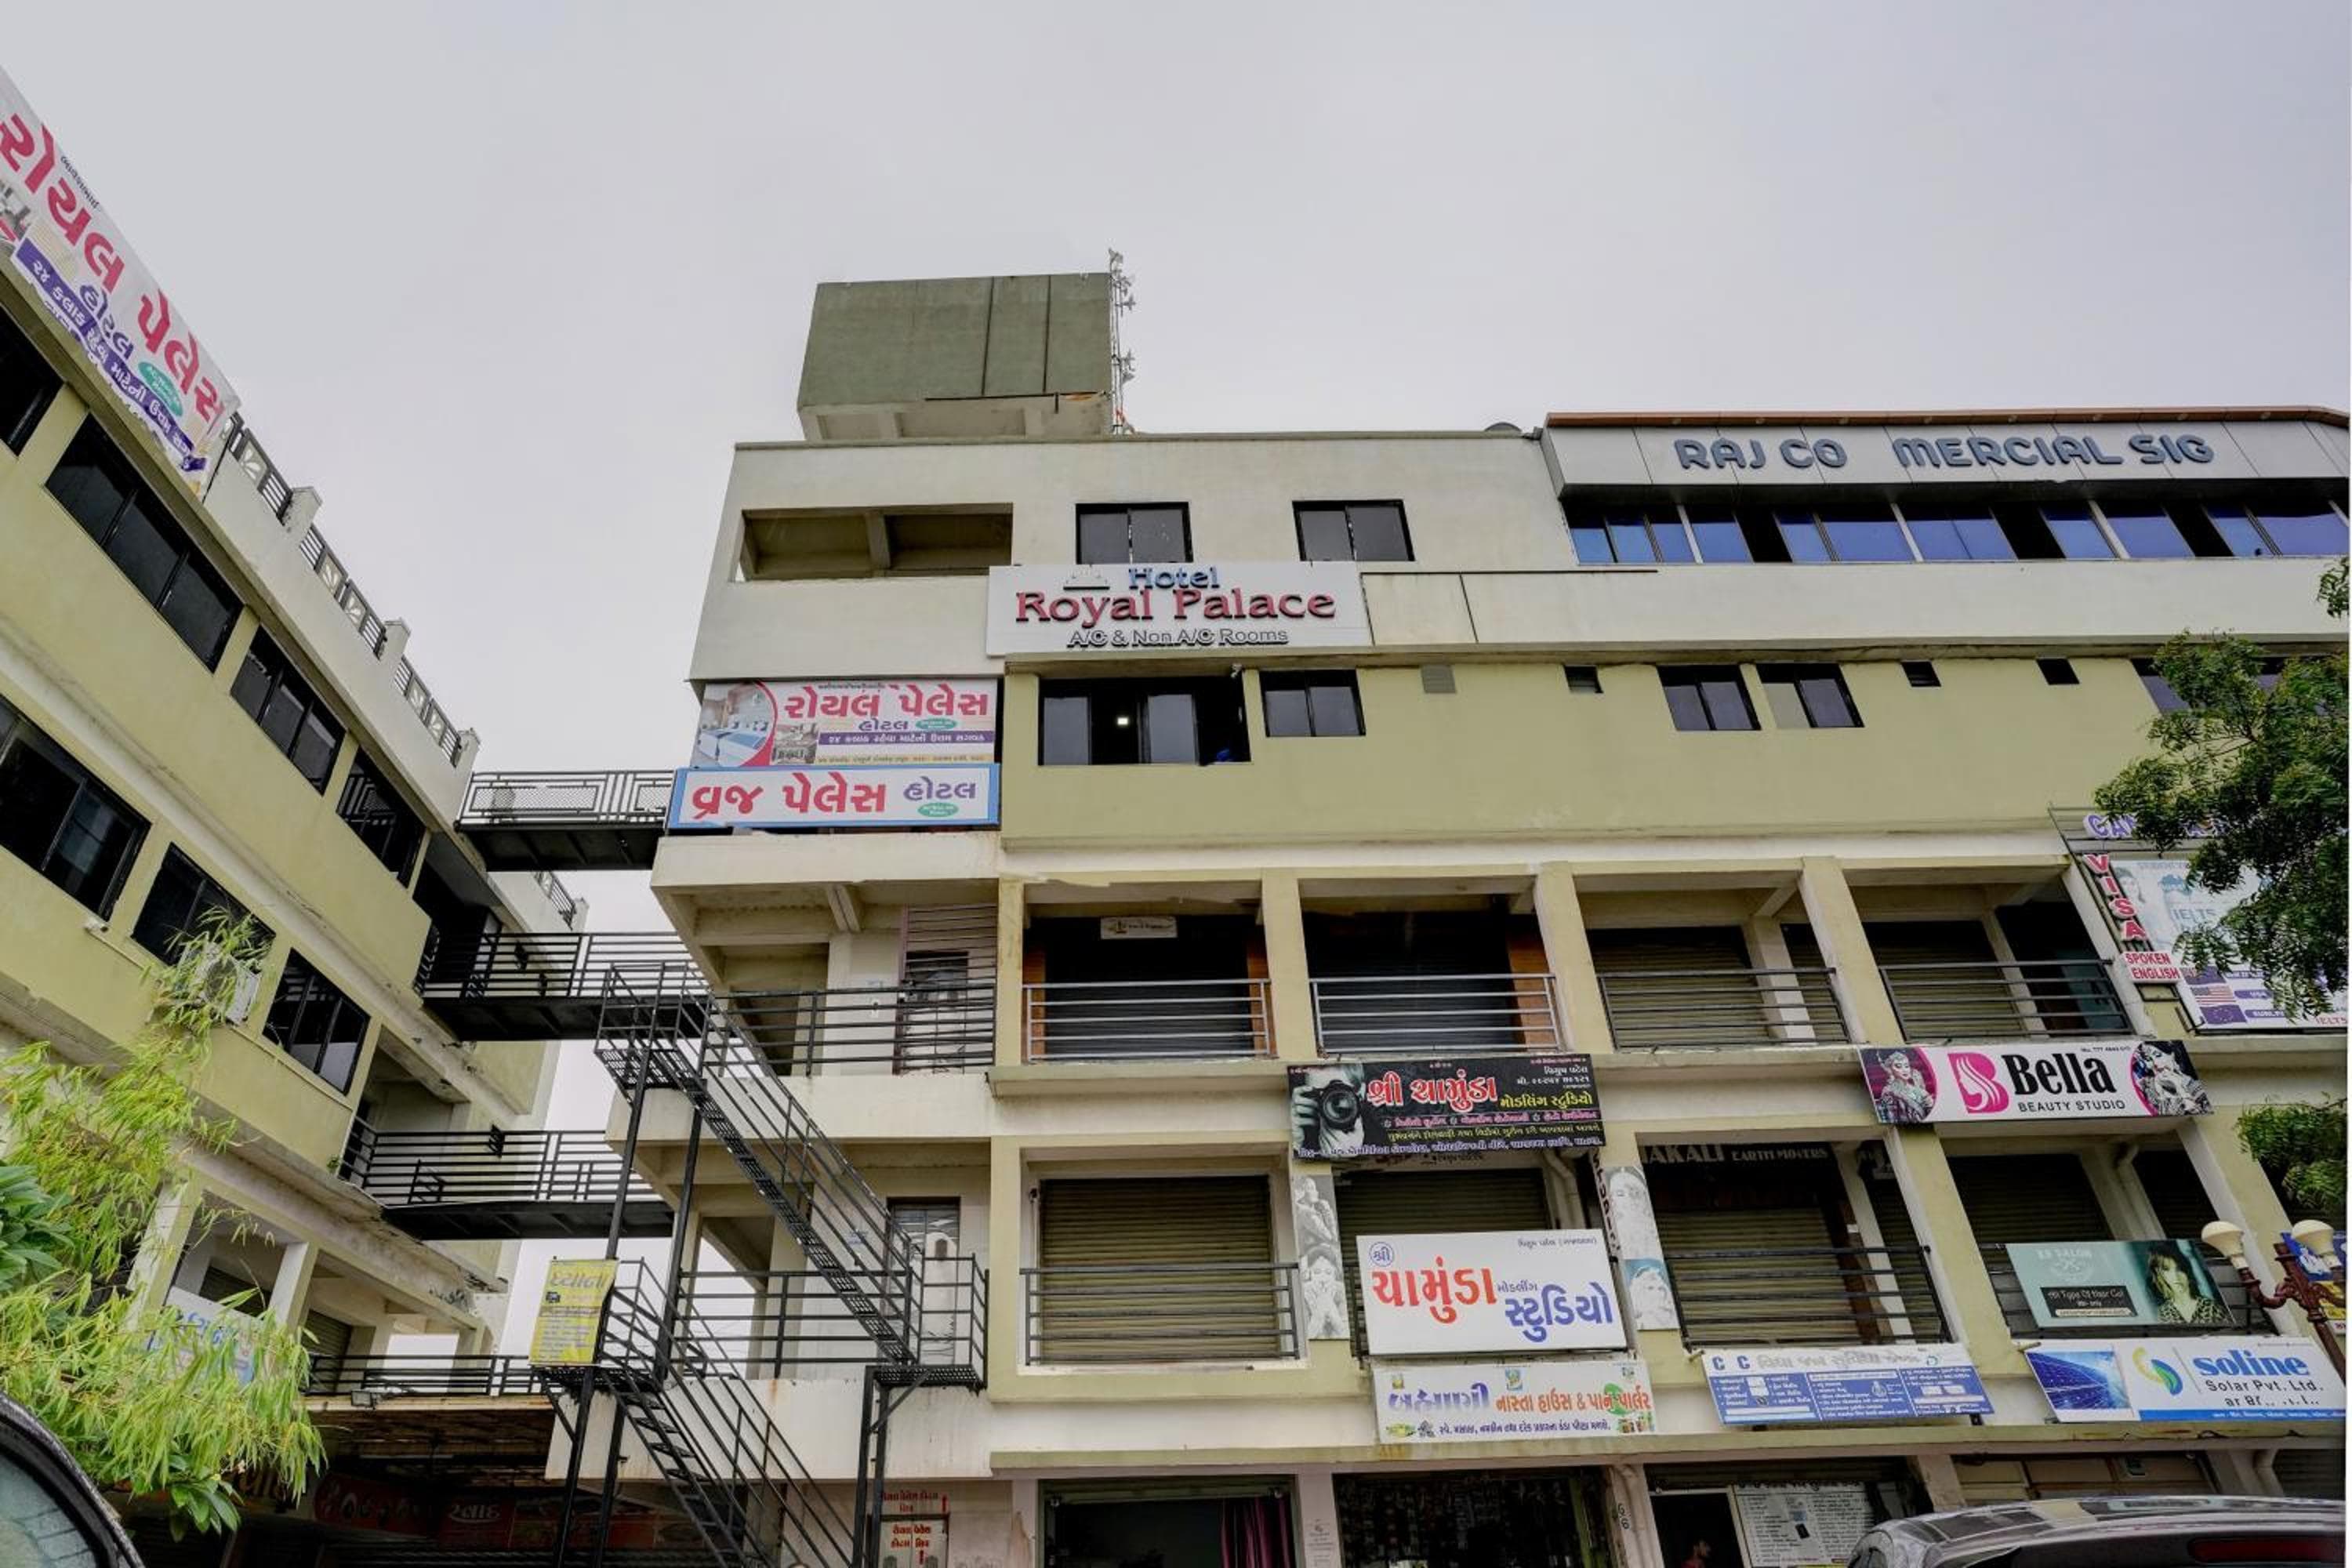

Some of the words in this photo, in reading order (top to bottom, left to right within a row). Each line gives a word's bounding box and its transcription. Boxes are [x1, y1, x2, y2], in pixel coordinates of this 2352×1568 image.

[1674, 437, 1767, 470] RAJ
[1778, 437, 1849, 469] CO
[1893, 435, 2123, 468] MERCIAL
[2129, 433, 2216, 464] SIG
[1128, 566, 1221, 590] Hotel
[1015, 589, 1153, 628] Royal
[1172, 588, 1336, 619] Palace
[1068, 629, 1107, 648] A/C
[1112, 630, 1129, 646] &
[1133, 629, 1174, 647] Non
[1177, 628, 1215, 647] A/C
[1219, 628, 1290, 645] Rooms
[782, 771, 886, 814] પેલેસ
[903, 775, 976, 801] હોટલ
[2125, 953, 2171, 964] SPOKEN
[2132, 967, 2180, 979] ENGLISH
[2000, 1052, 2118, 1095] Bella
[2017, 1101, 2072, 1112] BEAUTY
[2075, 1099, 2126, 1111] STUDIO
[1372, 1255, 1497, 1323] ચામુંડા
[1504, 1282, 1614, 1343] સ્ટુડિયો
[2192, 1348, 2310, 1376] soline
[2205, 1379, 2249, 1392] Solar
[2252, 1379, 2287, 1392] Pvt.
[2288, 1380, 2324, 1392] Ltd.
[1576, 1392, 1586, 1409] &
